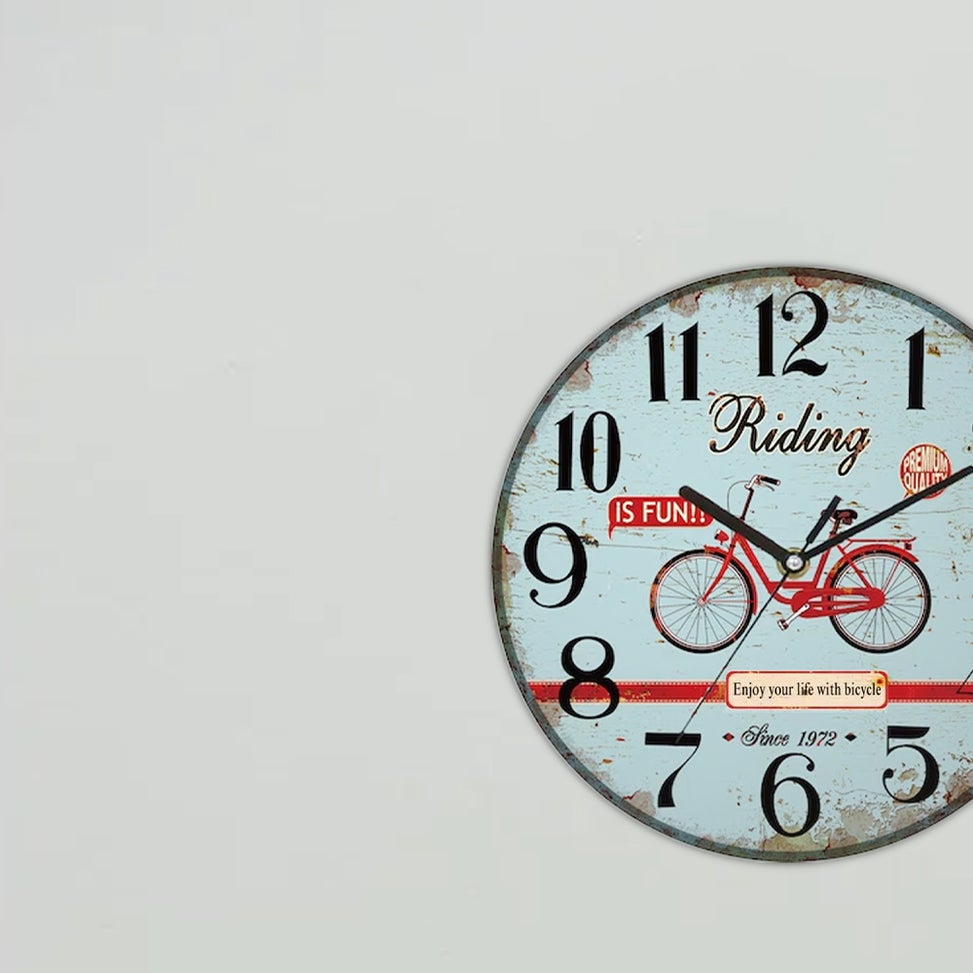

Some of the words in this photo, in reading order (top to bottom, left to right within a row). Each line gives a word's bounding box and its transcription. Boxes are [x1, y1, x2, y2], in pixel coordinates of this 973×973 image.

[645, 322, 701, 402] 11
[754, 290, 829, 377] 12
[905, 326, 925, 410] 1
[555, 410, 621, 493] 10
[708, 392, 871, 477] Riding
[903, 446, 948, 472] PREMIUM
[616, 501, 635, 523] IS
[523, 522, 588, 609] 9
[558, 636, 620, 720] 8
[733, 682, 766, 699] Enjoy
[768, 686, 794, 699] your
[797, 682, 814, 696] life
[817, 682, 841, 696] with
[844, 682, 882, 699] bicycle
[644, 731, 702, 808] 7
[740, 723, 790, 747] Since
[797, 730, 838, 747] 1972
[882, 726, 940, 804] 5
[760, 752, 821, 838] 6
